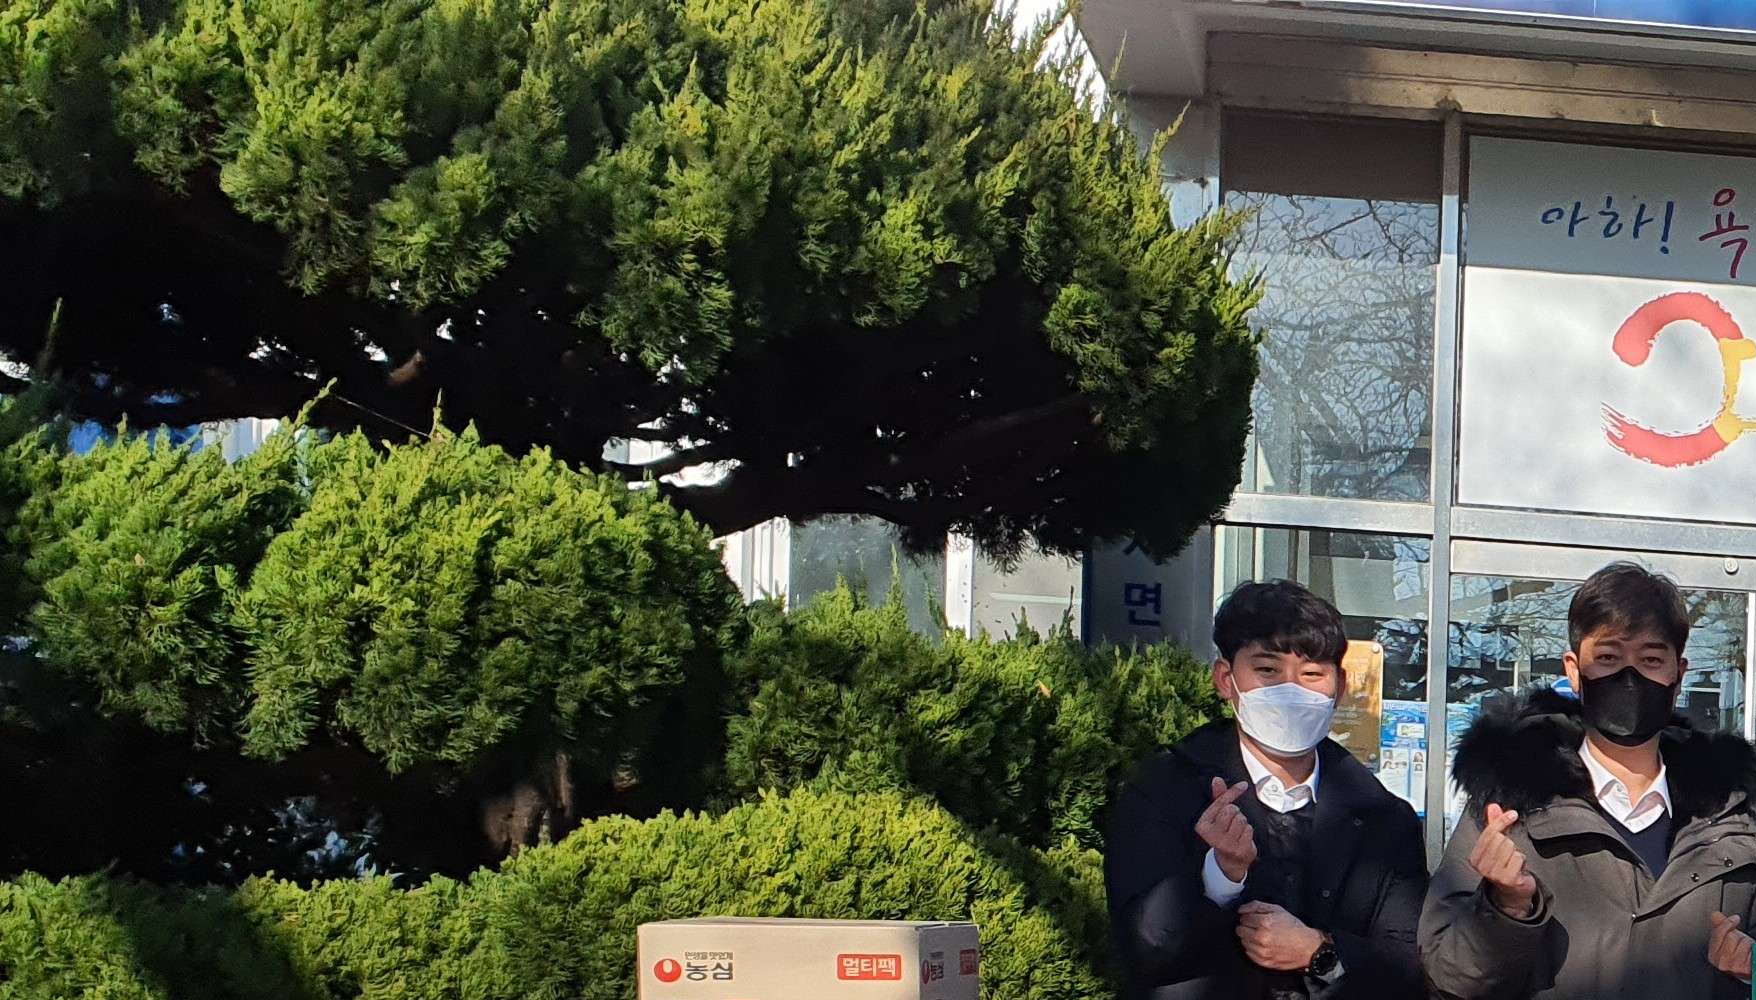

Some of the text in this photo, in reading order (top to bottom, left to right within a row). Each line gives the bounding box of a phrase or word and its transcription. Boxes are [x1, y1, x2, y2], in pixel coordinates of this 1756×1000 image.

[1542, 196, 1674, 256] 아하!
[685, 961, 733, 981] 농심
[842, 957, 896, 977] 멀티팩
